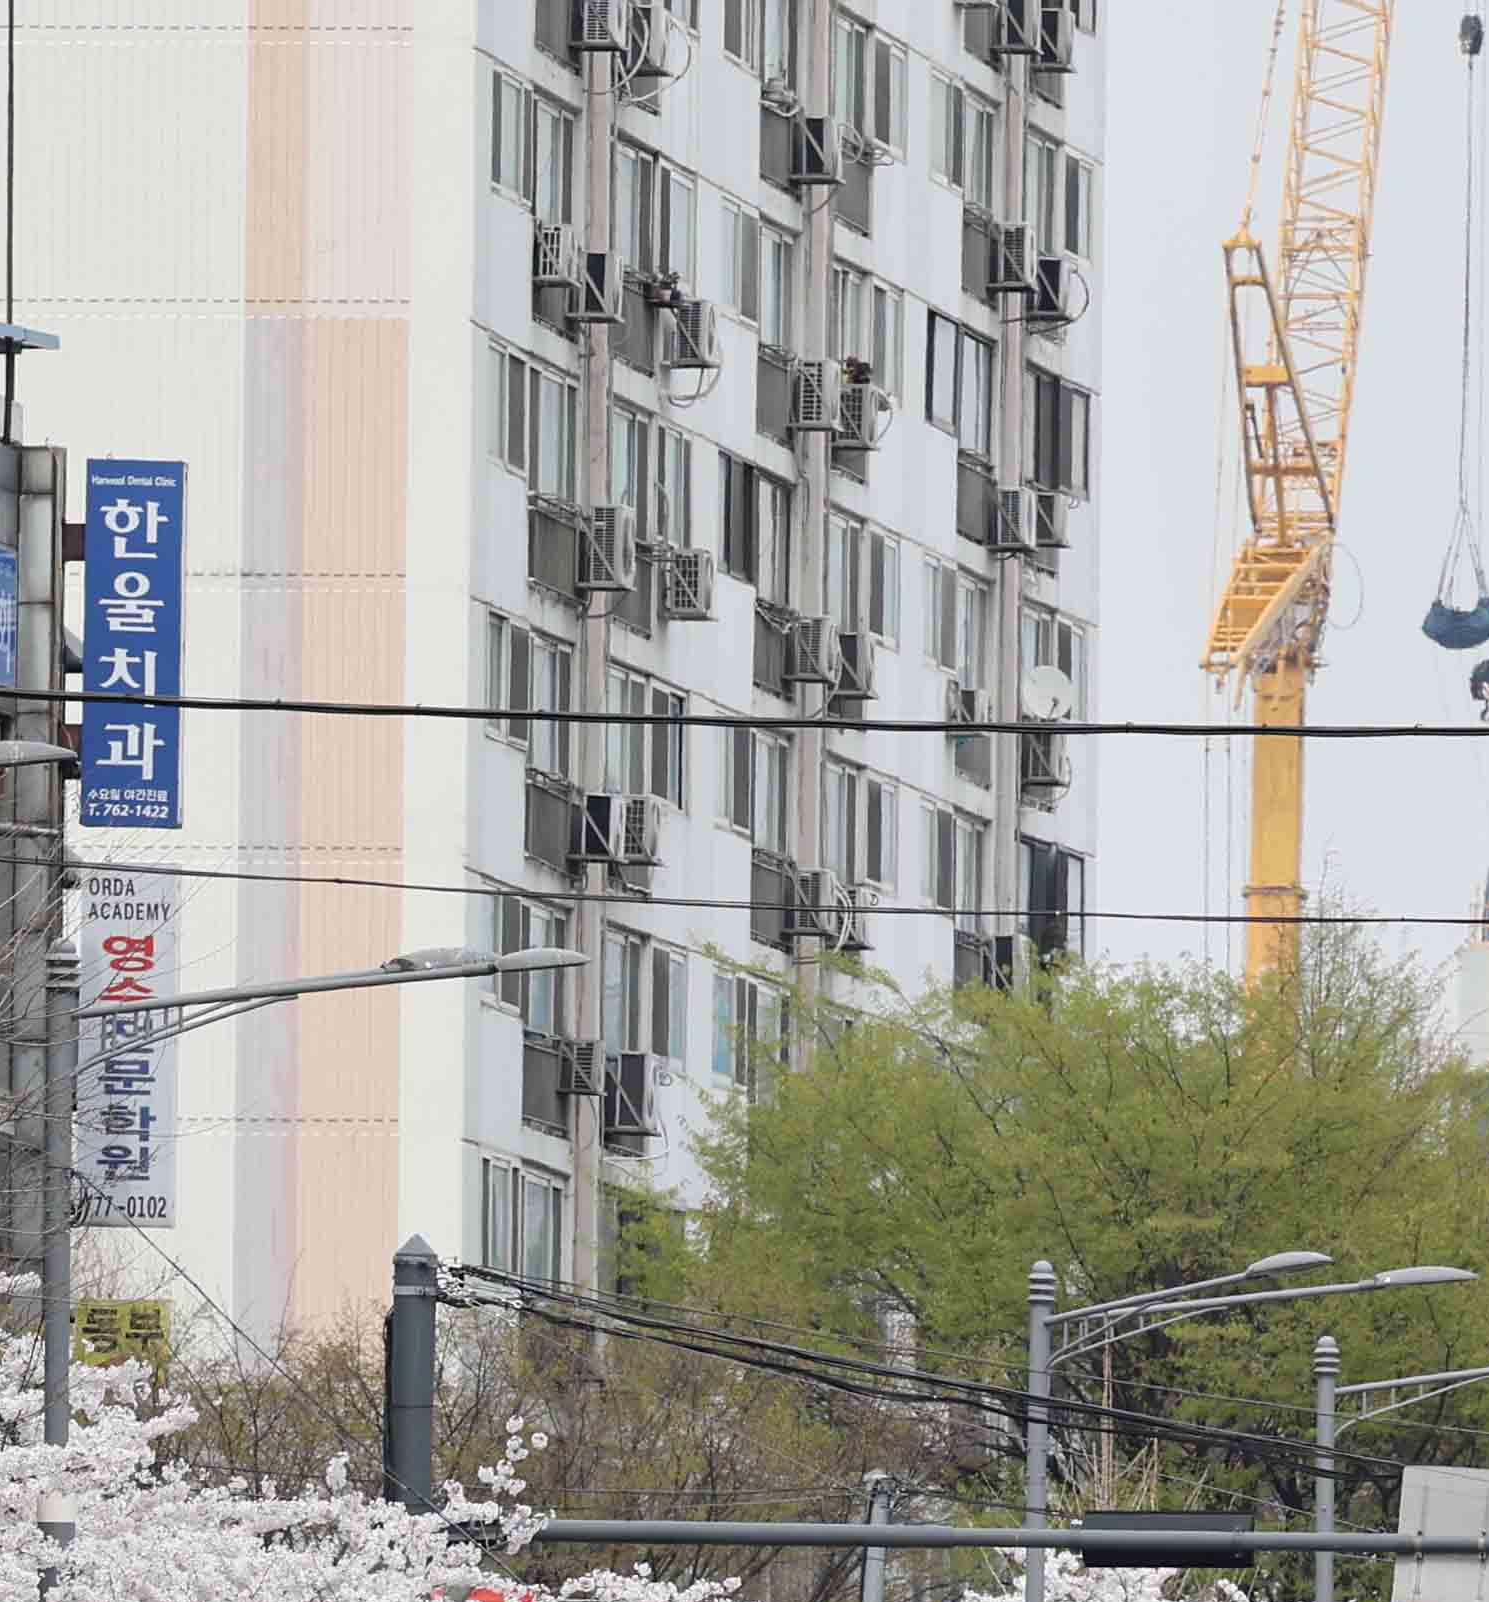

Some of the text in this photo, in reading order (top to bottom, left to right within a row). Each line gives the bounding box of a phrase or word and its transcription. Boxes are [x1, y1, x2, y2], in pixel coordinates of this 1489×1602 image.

[94, 498, 169, 781] 한울치과
[88, 877, 136, 897] ORDA
[88, 902, 171, 921] ACADEMY
